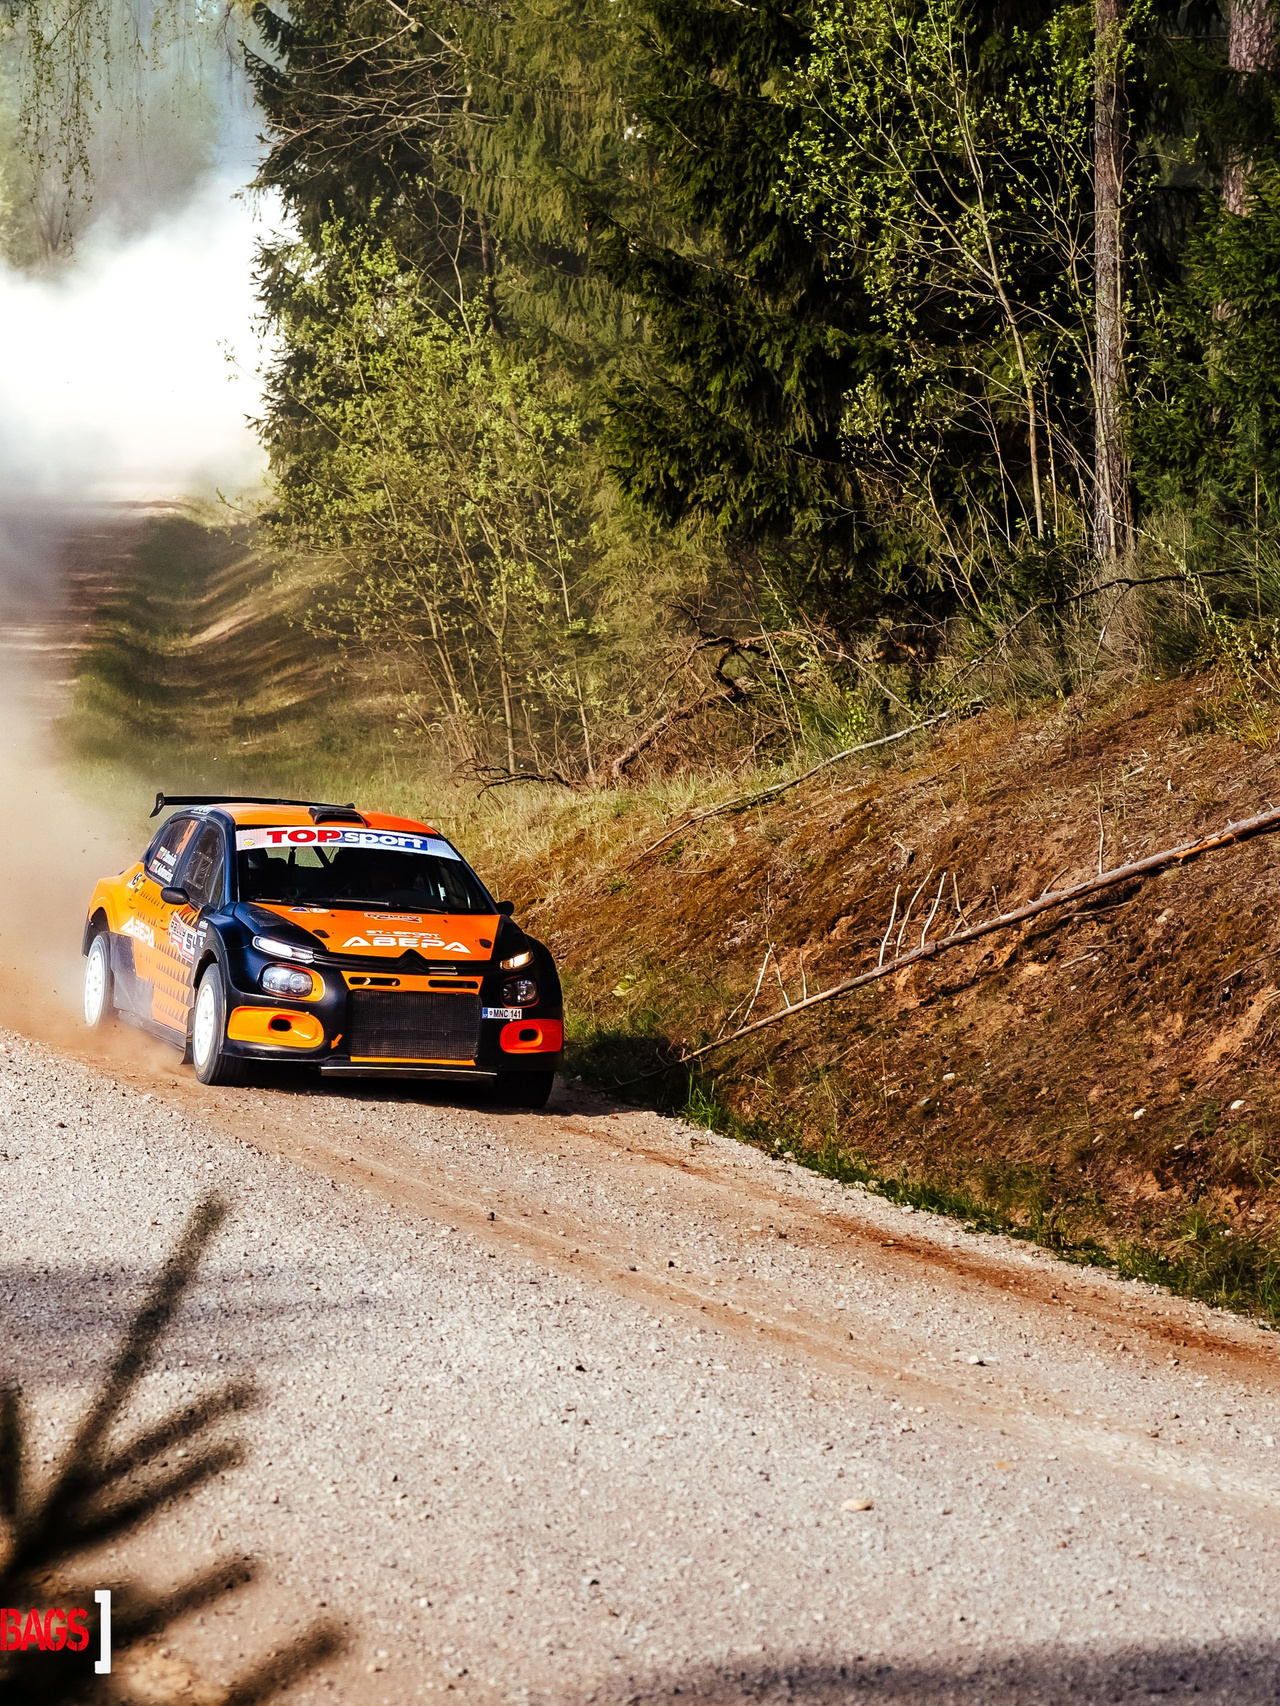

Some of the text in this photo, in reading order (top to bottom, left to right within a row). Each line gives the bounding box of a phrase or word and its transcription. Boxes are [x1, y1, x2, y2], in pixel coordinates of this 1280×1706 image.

[119, 915, 155, 948] ABEPA
[341, 936, 472, 954] ABEPA
[493, 1009, 521, 1018] MNC 141
